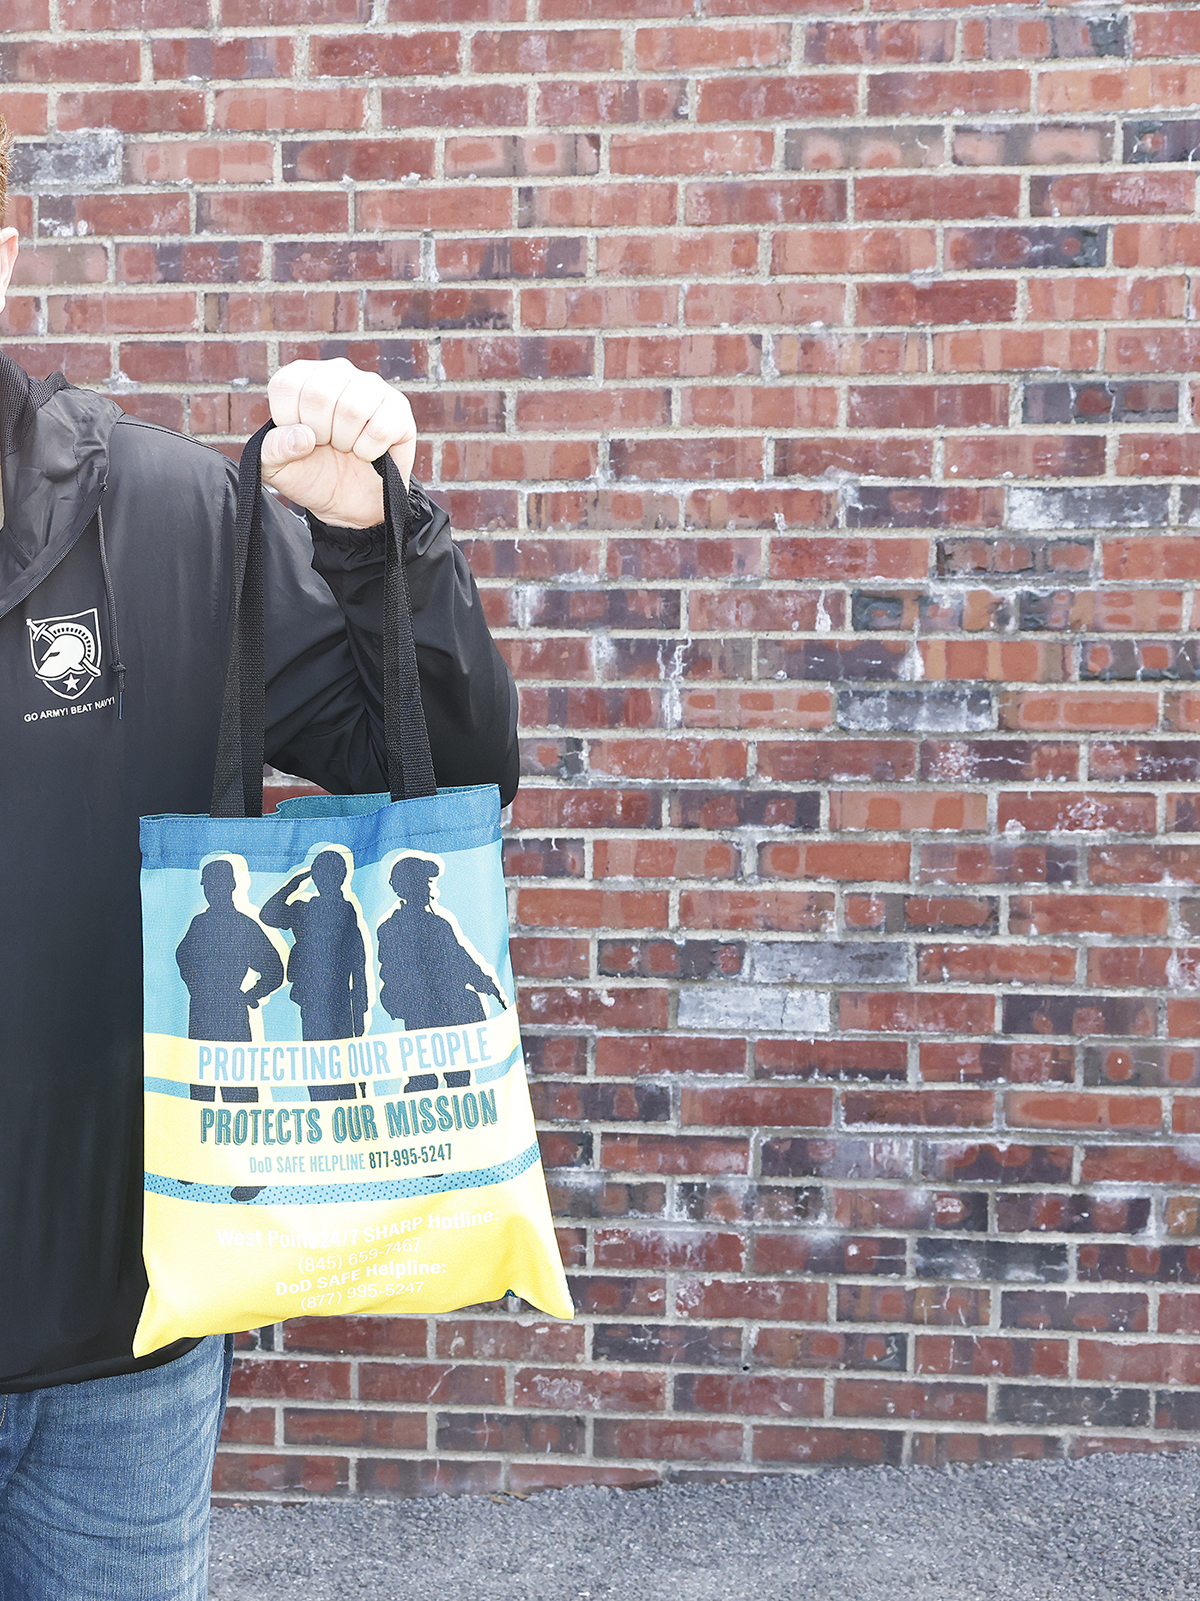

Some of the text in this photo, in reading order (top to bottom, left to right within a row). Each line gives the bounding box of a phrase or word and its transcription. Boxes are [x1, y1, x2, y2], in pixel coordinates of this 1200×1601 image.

[24, 697, 115, 722] GO ARMY! BEAT NAVY!
[198, 1026, 492, 1082] PROTECTING OUR PEOPLE
[201, 1088, 499, 1146] PROTECTS OUR MISSION
[249, 1142, 452, 1173] DoD SAFE HELPLINE 877-995-5247
[216, 1209, 500, 1250] West Point 24/7 SHARP Hotline:
[298, 1237, 422, 1275] (845) 659-7467
[275, 1260, 448, 1297] DoD SAFE Helpline:
[300, 1281, 425, 1311] (877) 995-5247
